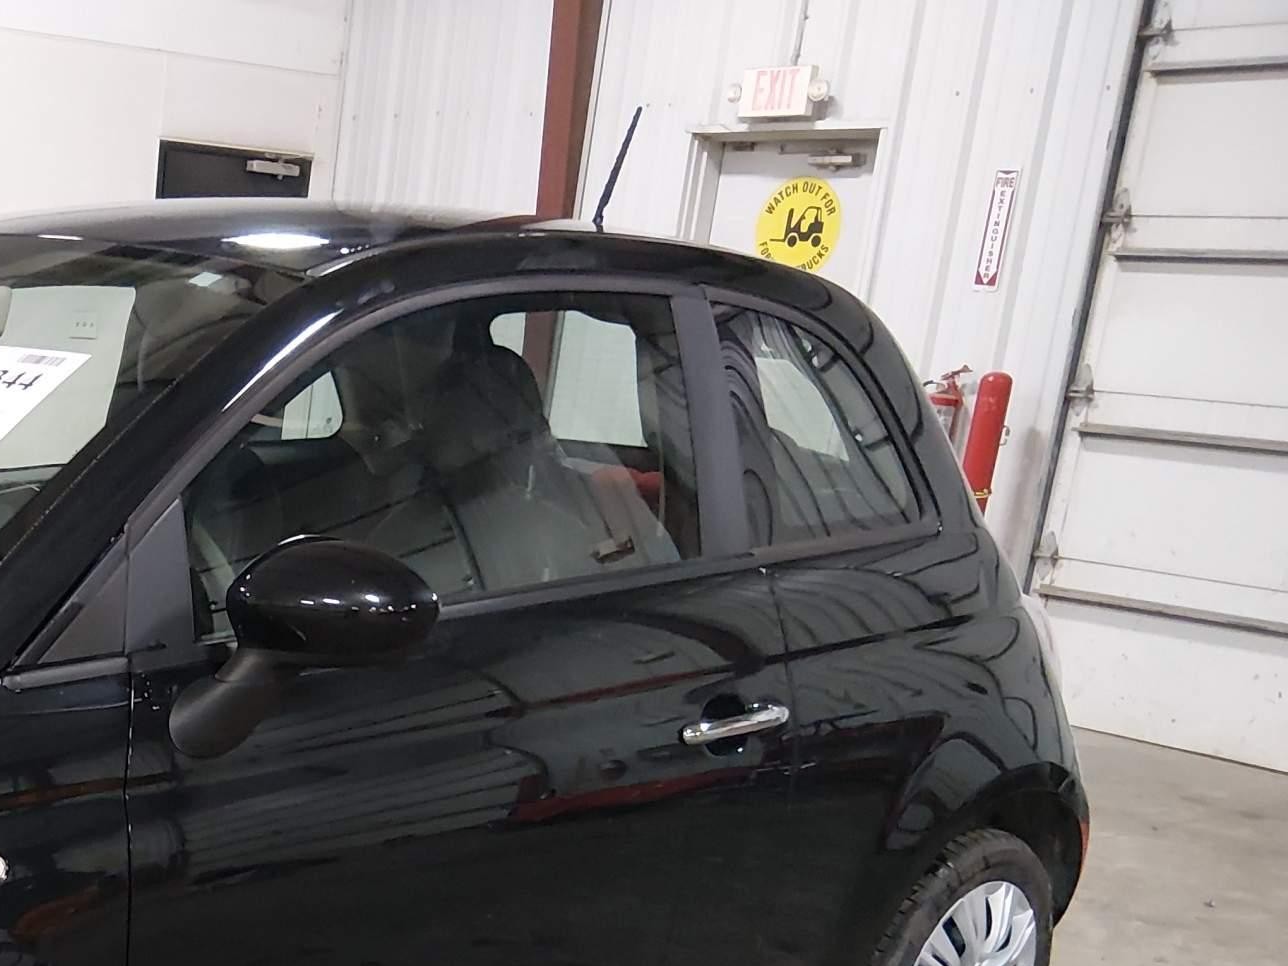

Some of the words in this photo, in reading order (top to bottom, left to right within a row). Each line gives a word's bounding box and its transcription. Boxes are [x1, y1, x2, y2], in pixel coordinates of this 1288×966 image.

[752, 68, 800, 111] EXIT
[765, 183, 799, 215] WATCH
[802, 181, 823, 196] OUT
[820, 192, 837, 216] FOR
[995, 176, 1015, 188] FIRE
[983, 190, 1007, 279] EXTINGUISHER
